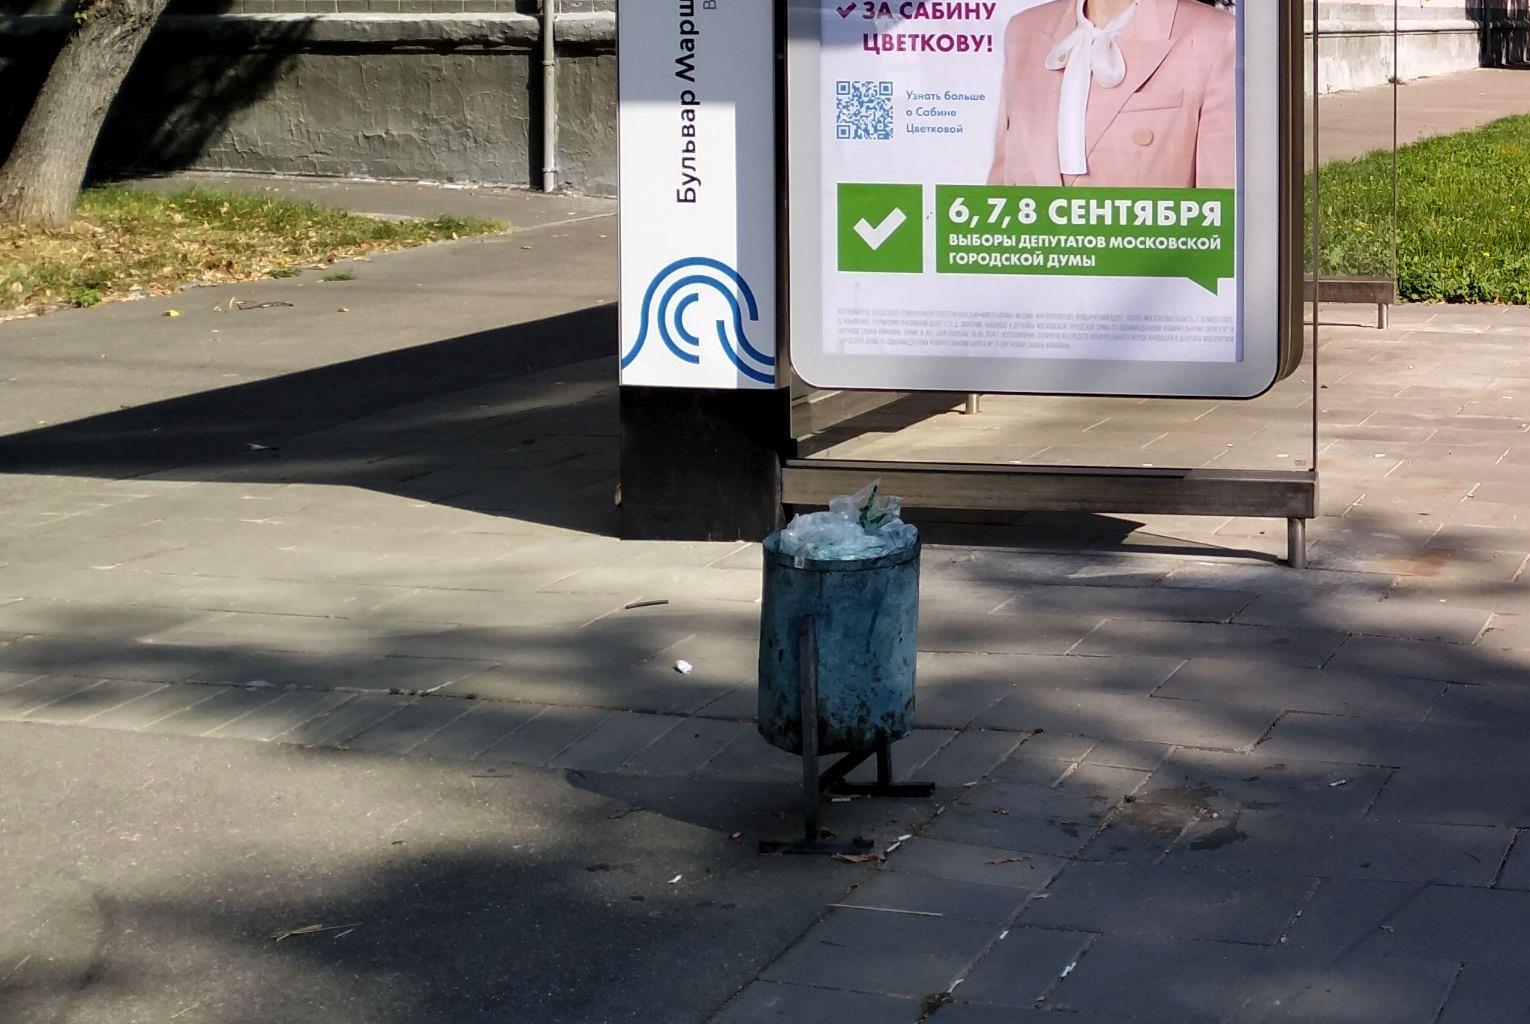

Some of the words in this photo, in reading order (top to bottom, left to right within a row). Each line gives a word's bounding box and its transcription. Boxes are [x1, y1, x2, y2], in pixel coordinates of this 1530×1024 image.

[862, 1, 893, 20] ЗА
[899, 1, 997, 20] САБИНУ
[863, 33, 993, 55] ЦВЕТКОВУ!
[906, 91, 942, 102] Узнать
[944, 90, 985, 101] больше
[906, 109, 913, 117] о
[915, 107, 957, 118] Сабине
[906, 123, 963, 136] Цветковой
[676, 90, 701, 204] Бульвар
[1048, 199, 1222, 227] СЕНТЯБРЯ
[949, 234, 1016, 247] ВЫБОРЫ
[1018, 234, 1107, 249] ДЕПУТАТОВ
[1109, 233, 1221, 250] МОСКОВСКОЙ
[949, 249, 1044, 267] ГОРОДСКОЙ
[1046, 254, 1096, 268] ДУМЫ
